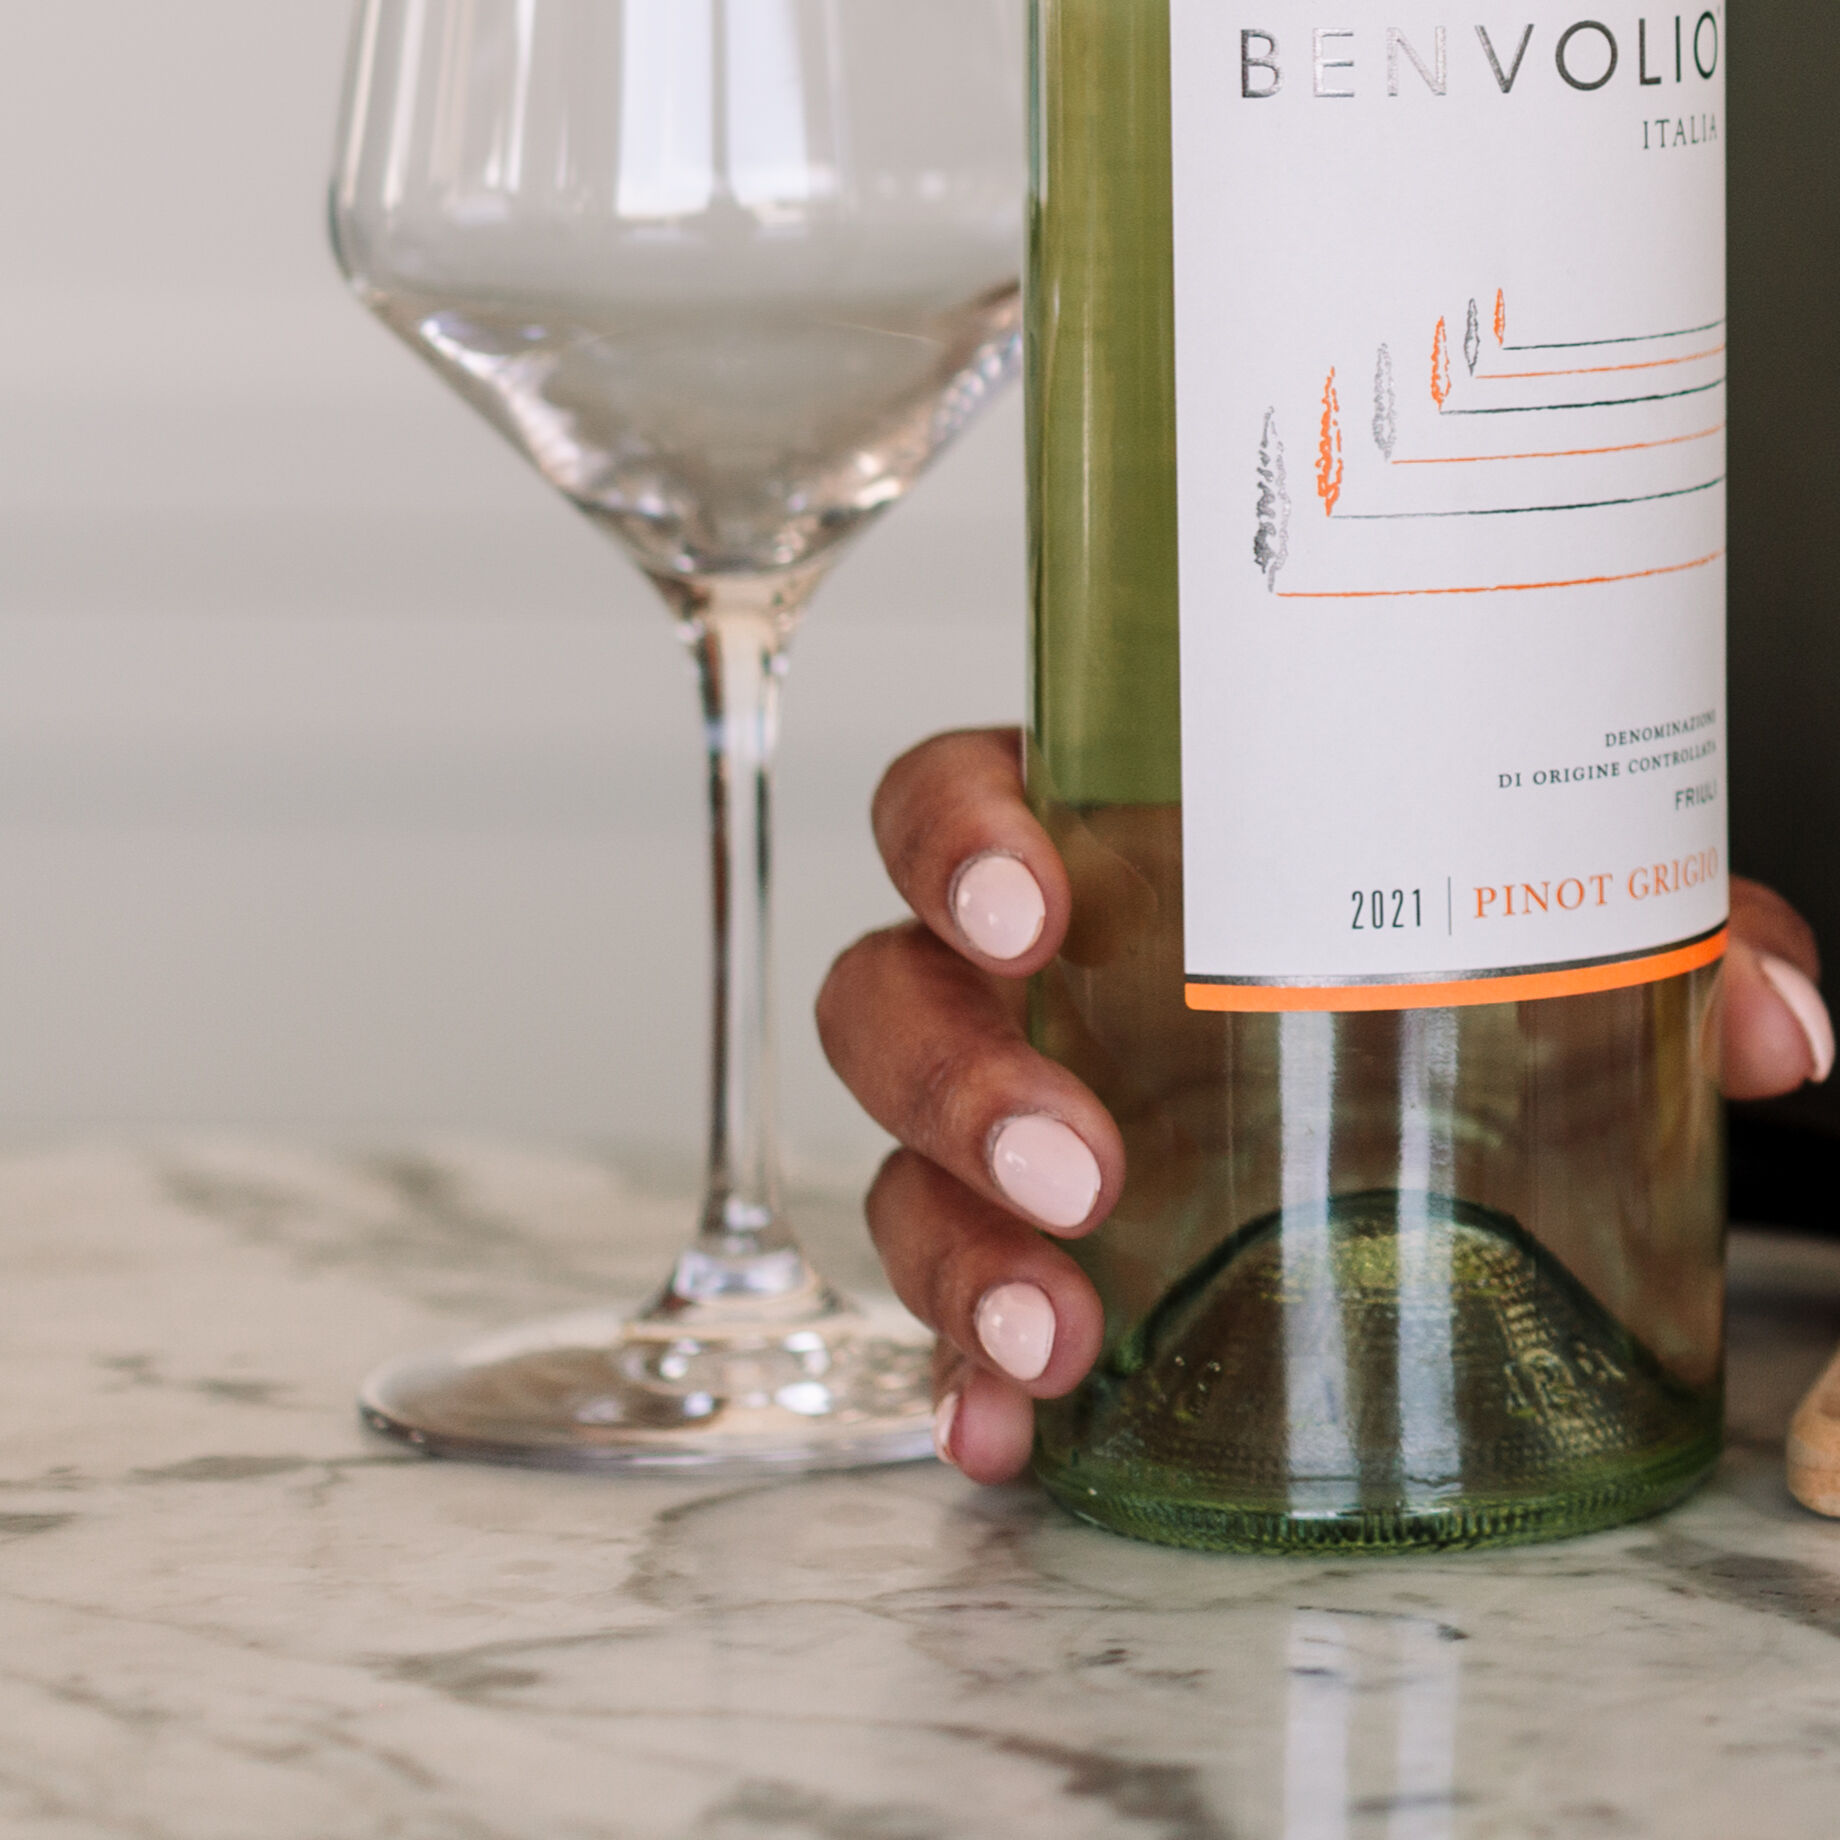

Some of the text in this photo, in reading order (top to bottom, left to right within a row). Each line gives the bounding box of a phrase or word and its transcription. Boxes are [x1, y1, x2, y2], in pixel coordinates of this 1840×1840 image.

[1240, 10, 1718, 98] BENVOLIO
[1643, 114, 1717, 149] ITALIA
[1499, 773, 1521, 788] DI
[1533, 762, 1620, 785] ORIGINE
[1352, 845, 1718, 929] 2021 PINOT GRIGIO
